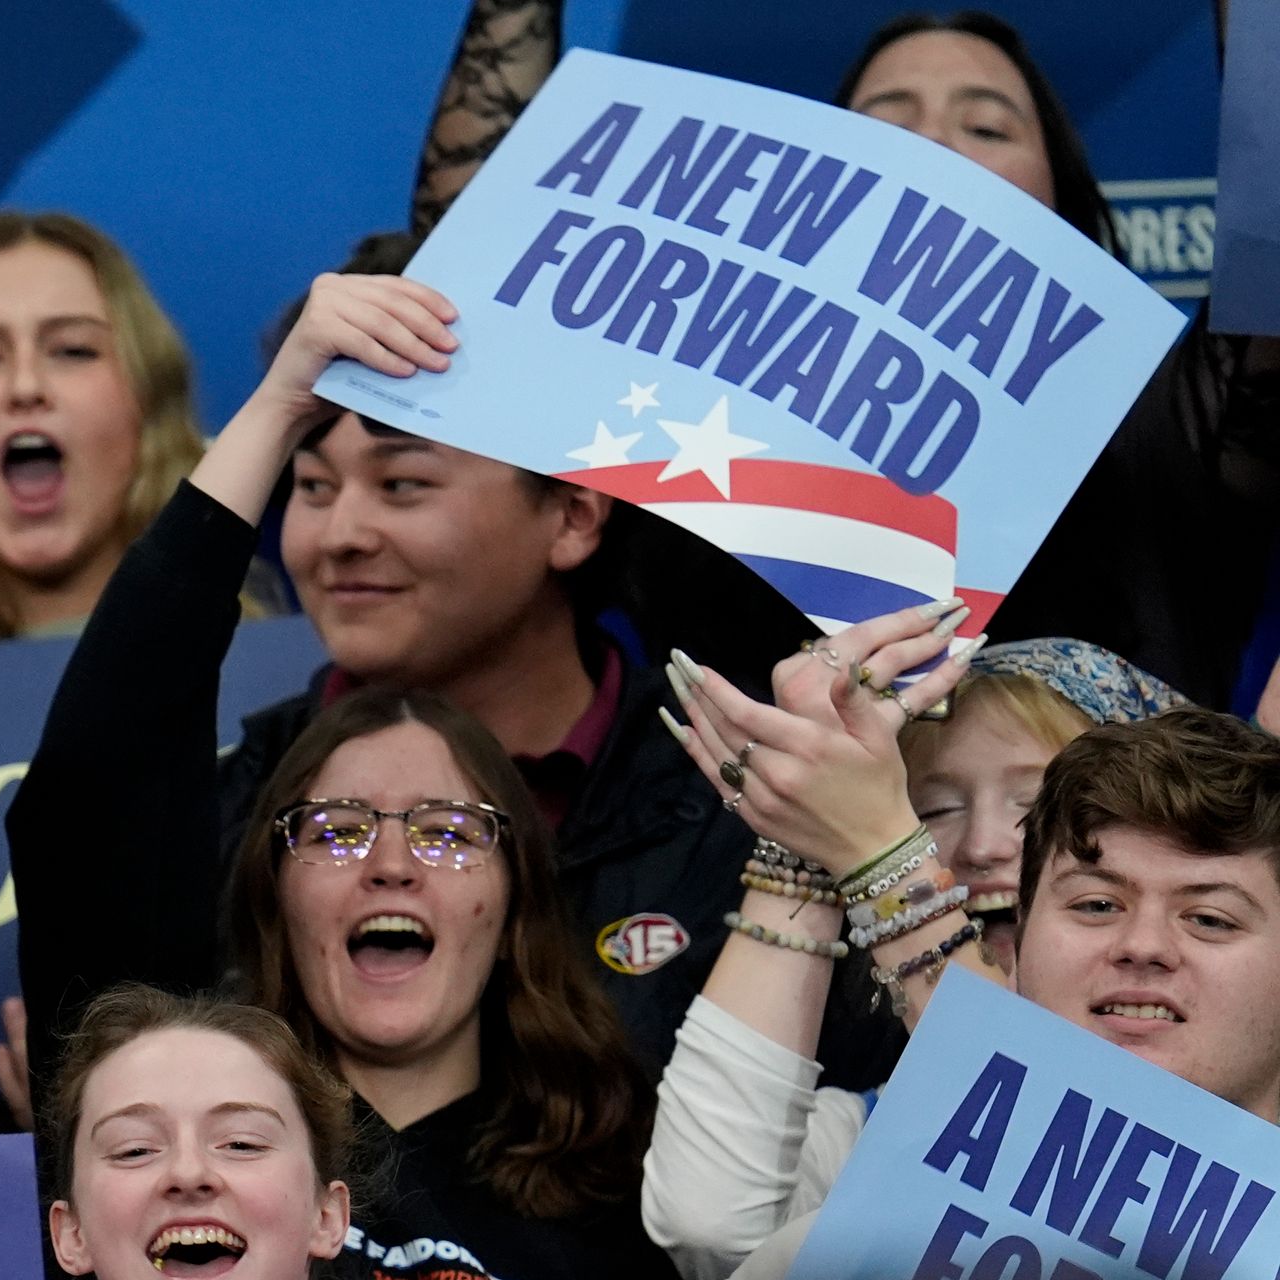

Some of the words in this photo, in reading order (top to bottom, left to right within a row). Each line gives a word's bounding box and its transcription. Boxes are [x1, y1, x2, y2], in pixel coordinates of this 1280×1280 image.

[493, 208, 982, 498] FORWARD
[535, 101, 644, 198] A
[618, 116, 882, 268] NEW
[856, 187, 1106, 407] WAY
[922, 1050, 1029, 1193] A
